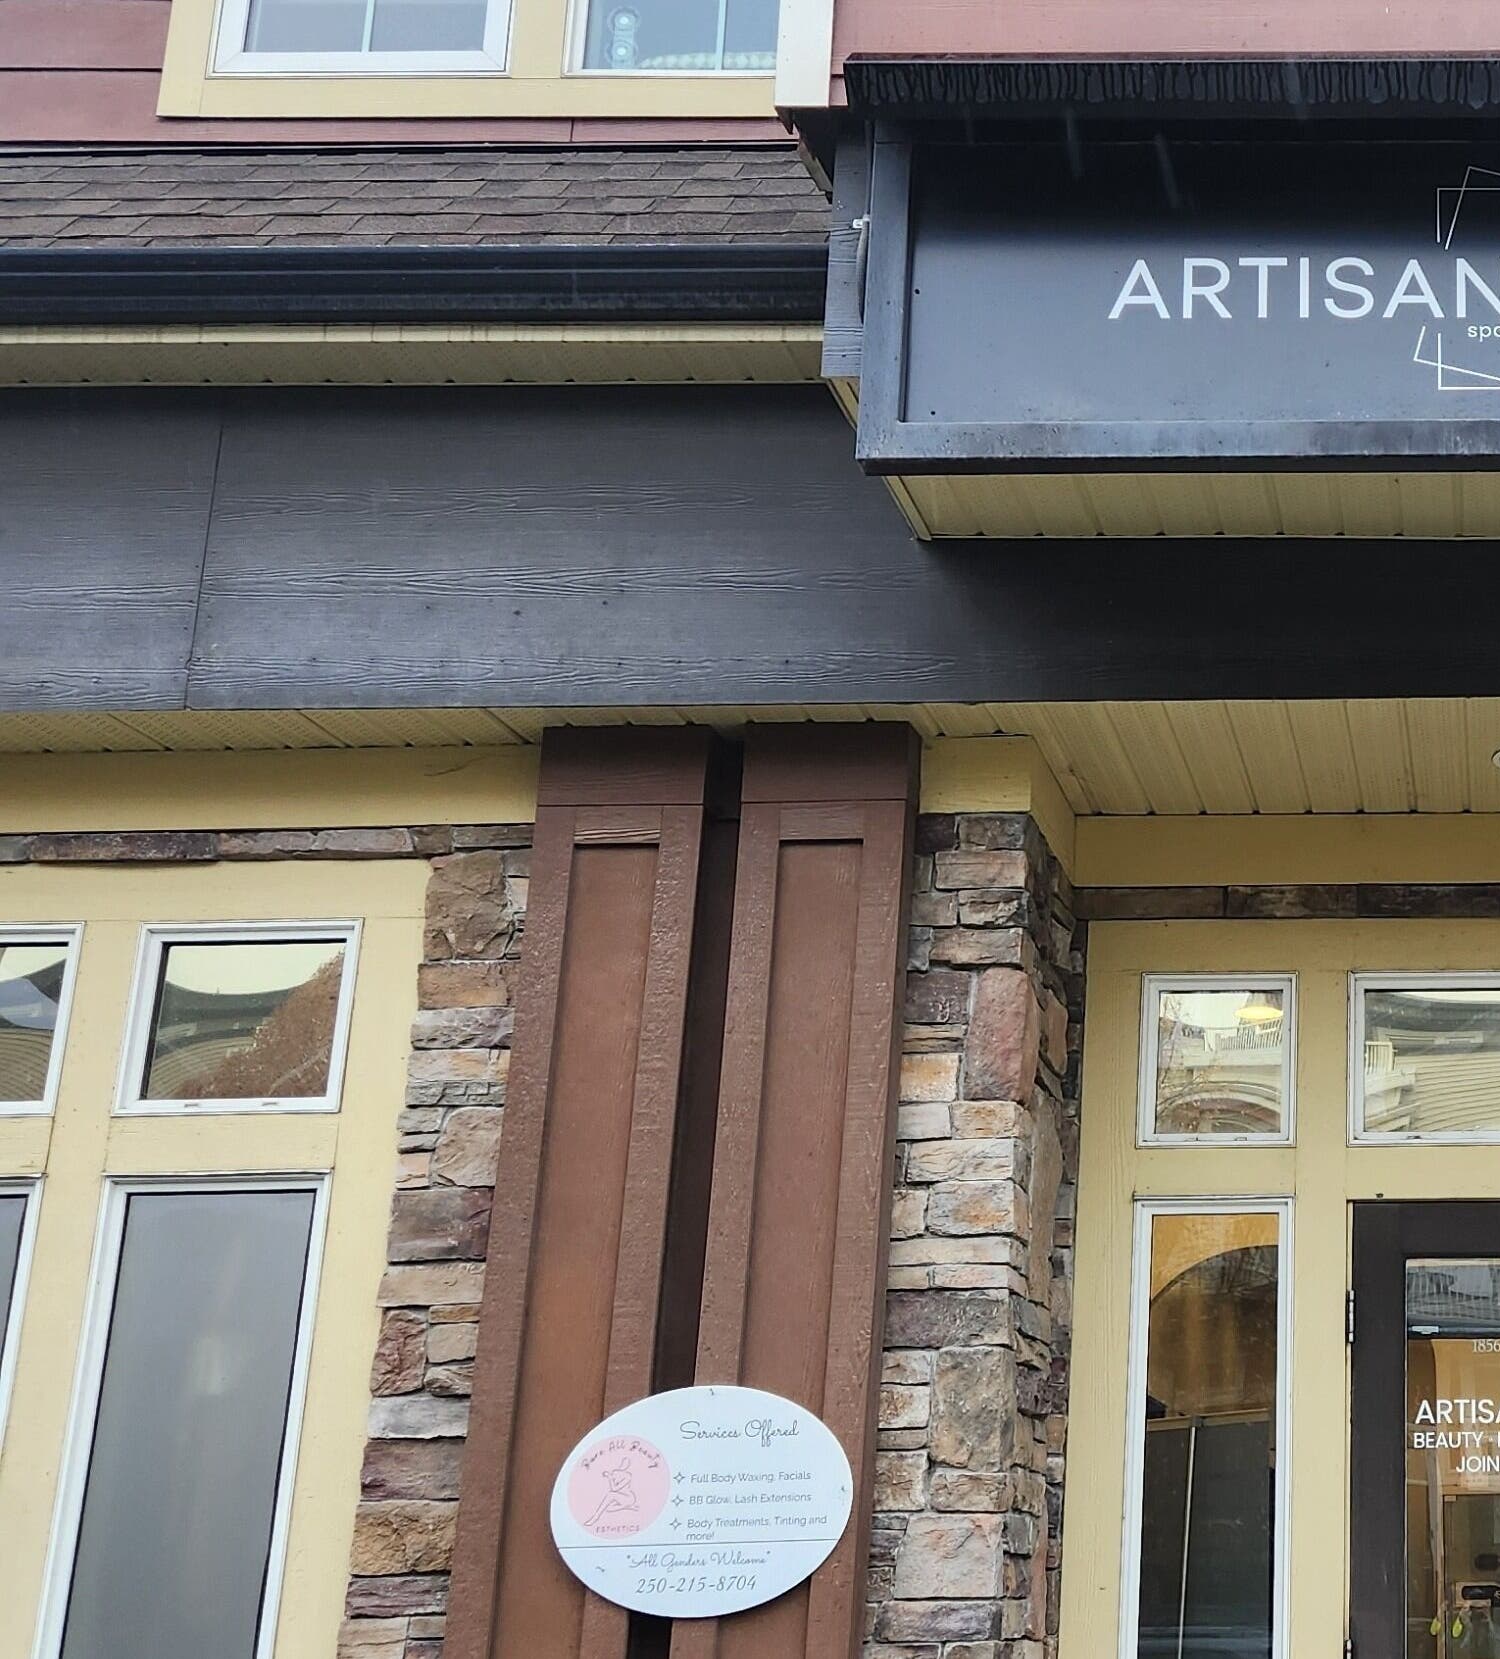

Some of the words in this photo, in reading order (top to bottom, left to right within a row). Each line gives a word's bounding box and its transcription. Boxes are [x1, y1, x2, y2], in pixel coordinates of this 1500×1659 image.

[1472, 1339, 1500, 1353] 1856
[680, 1420, 740, 1440] Services
[745, 1418, 799, 1447] Offered
[609, 1440, 626, 1452] All
[1413, 1432, 1484, 1449] BEAUTY
[690, 1474, 710, 1483] Full
[711, 1473, 736, 1484] Body
[778, 1471, 812, 1480] Facials
[689, 1496, 704, 1505] BB
[735, 1494, 758, 1504] Lash
[760, 1492, 812, 1503] Extensions
[687, 1518, 713, 1529] Body
[774, 1515, 807, 1527] Tinting
[809, 1515, 828, 1525] and
[686, 1531, 715, 1541] more!
[661, 1552, 706, 1573] Genders
[635, 1575, 757, 1594] 250-215-8704
